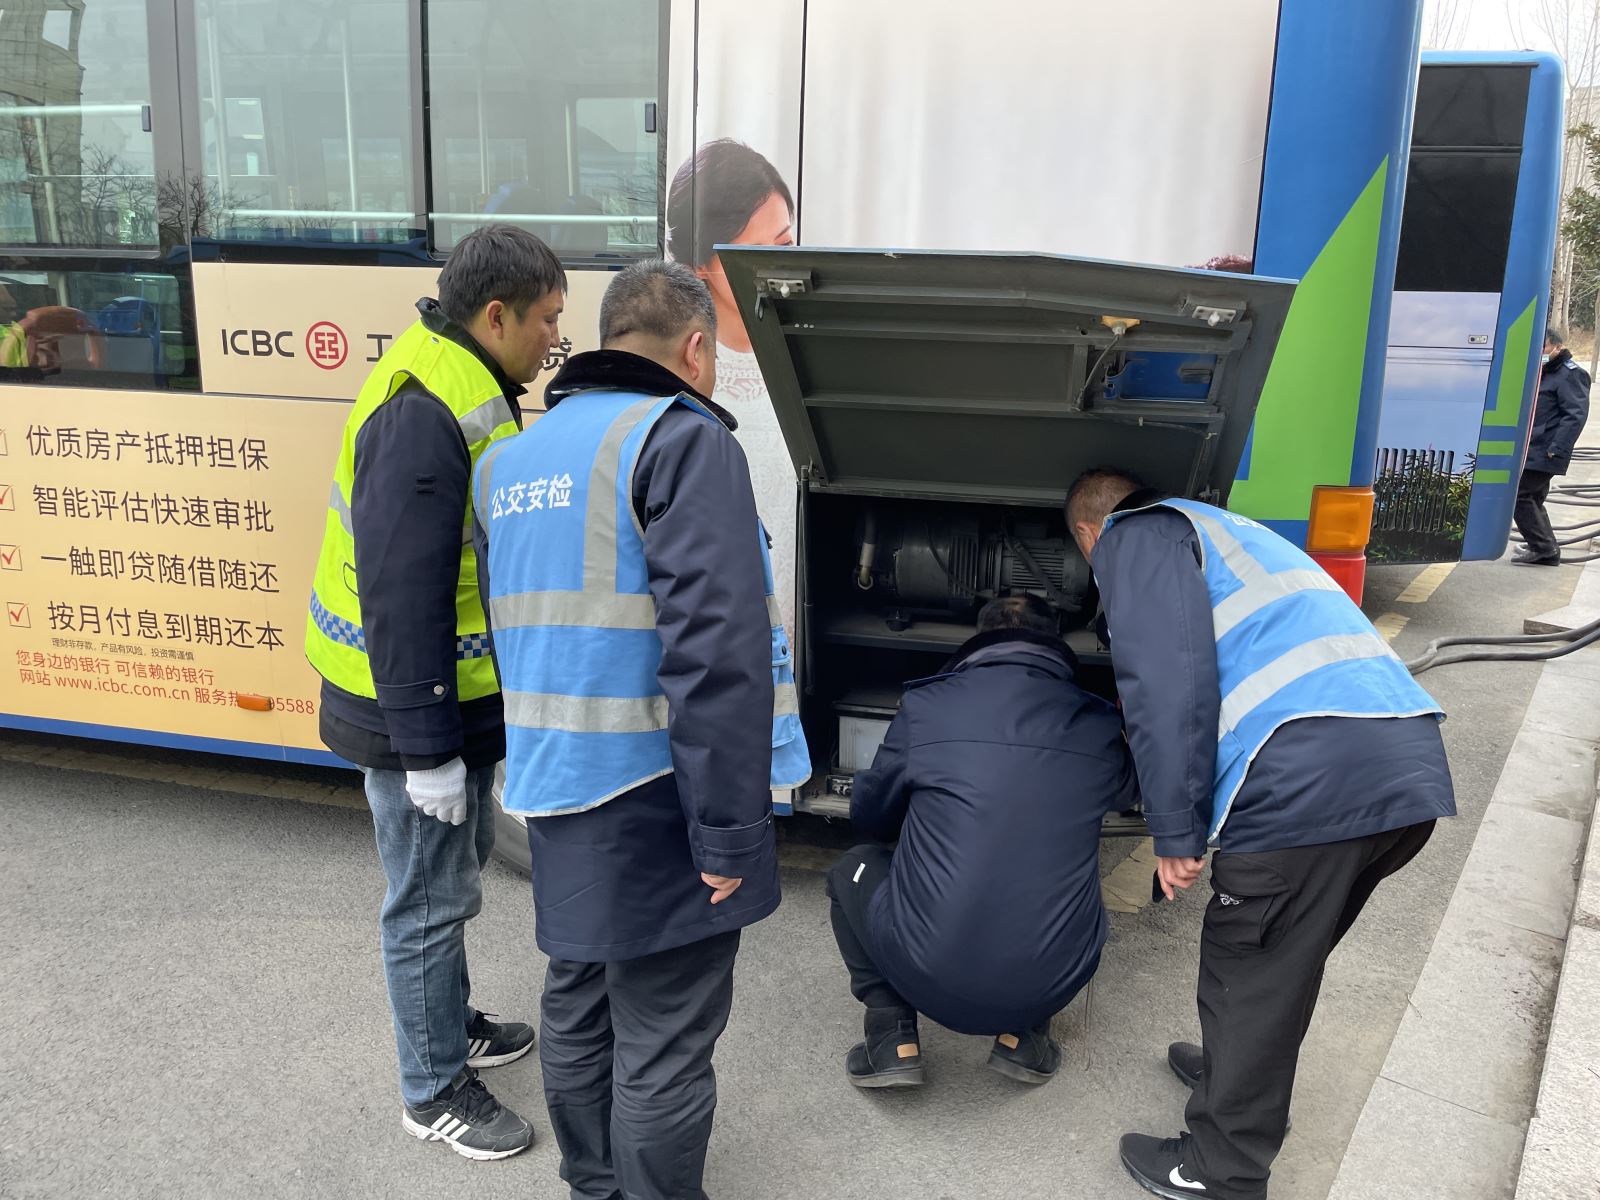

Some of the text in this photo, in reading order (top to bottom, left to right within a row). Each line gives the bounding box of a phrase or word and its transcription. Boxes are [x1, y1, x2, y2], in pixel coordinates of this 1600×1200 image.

[221, 328, 295, 358] ICBC
[25, 424, 270, 471] 优质房产抵押担保
[32, 484, 274, 533] 智能评估快速审批
[492, 473, 573, 520] 公交安检
[40, 545, 280, 593] 一触即贷随借随还
[47, 600, 285, 651] 按月付息到期还本
[16, 650, 215, 686] 您身边的银行 可信赖的银行
[20, 669, 51, 686] 网站
[55, 675, 190, 701] www.icbc.com.cn
